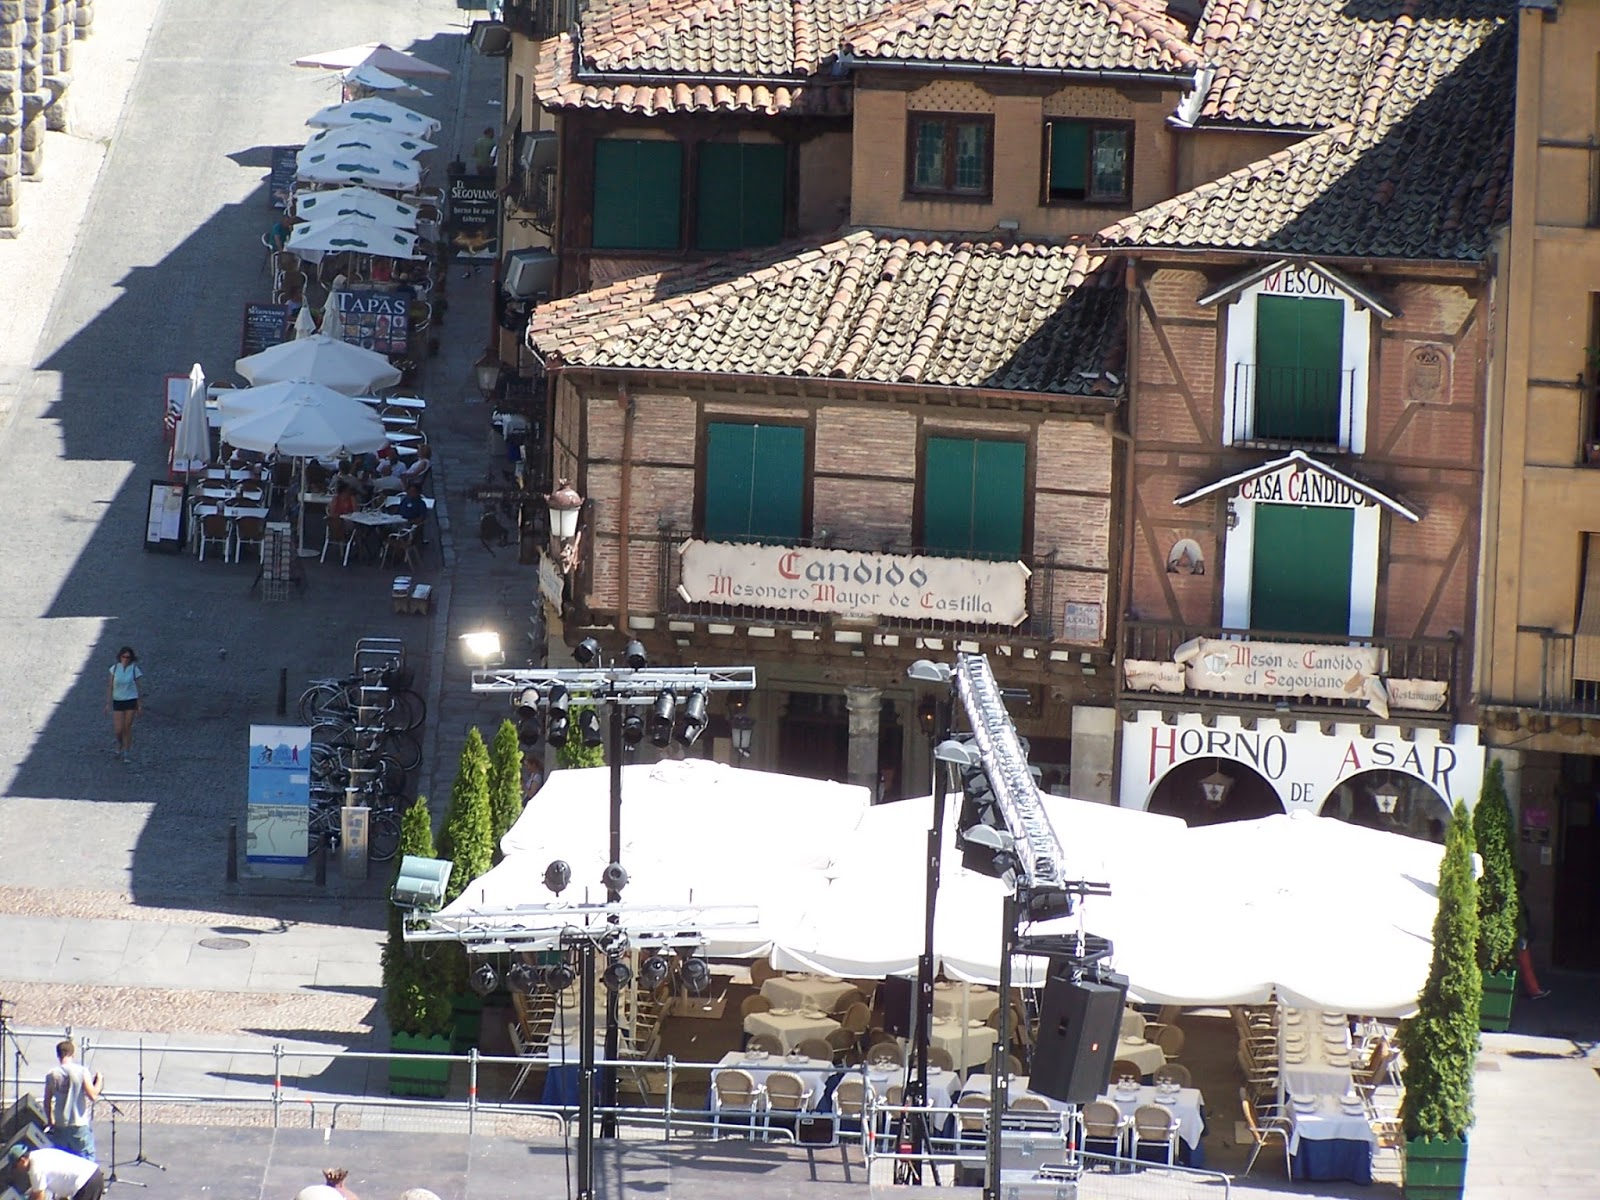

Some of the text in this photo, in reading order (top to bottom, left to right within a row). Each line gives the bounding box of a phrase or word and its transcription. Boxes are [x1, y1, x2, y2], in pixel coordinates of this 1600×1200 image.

[452, 187, 498, 199] SEGOVIANO
[456, 180, 465, 188] EL
[1263, 270, 1336, 295] MESON
[337, 292, 405, 315] TAPAS
[1242, 472, 1363, 504] CASA CANDIDO
[778, 551, 928, 588] Candido
[708, 574, 992, 613] Mesonero Mayor de Castilla
[1287, 657, 1298, 669] de
[1302, 650, 1363, 671] Candido
[1244, 669, 1344, 693] el Segoviano
[1149, 726, 1458, 810] HORNO DE ASAR
